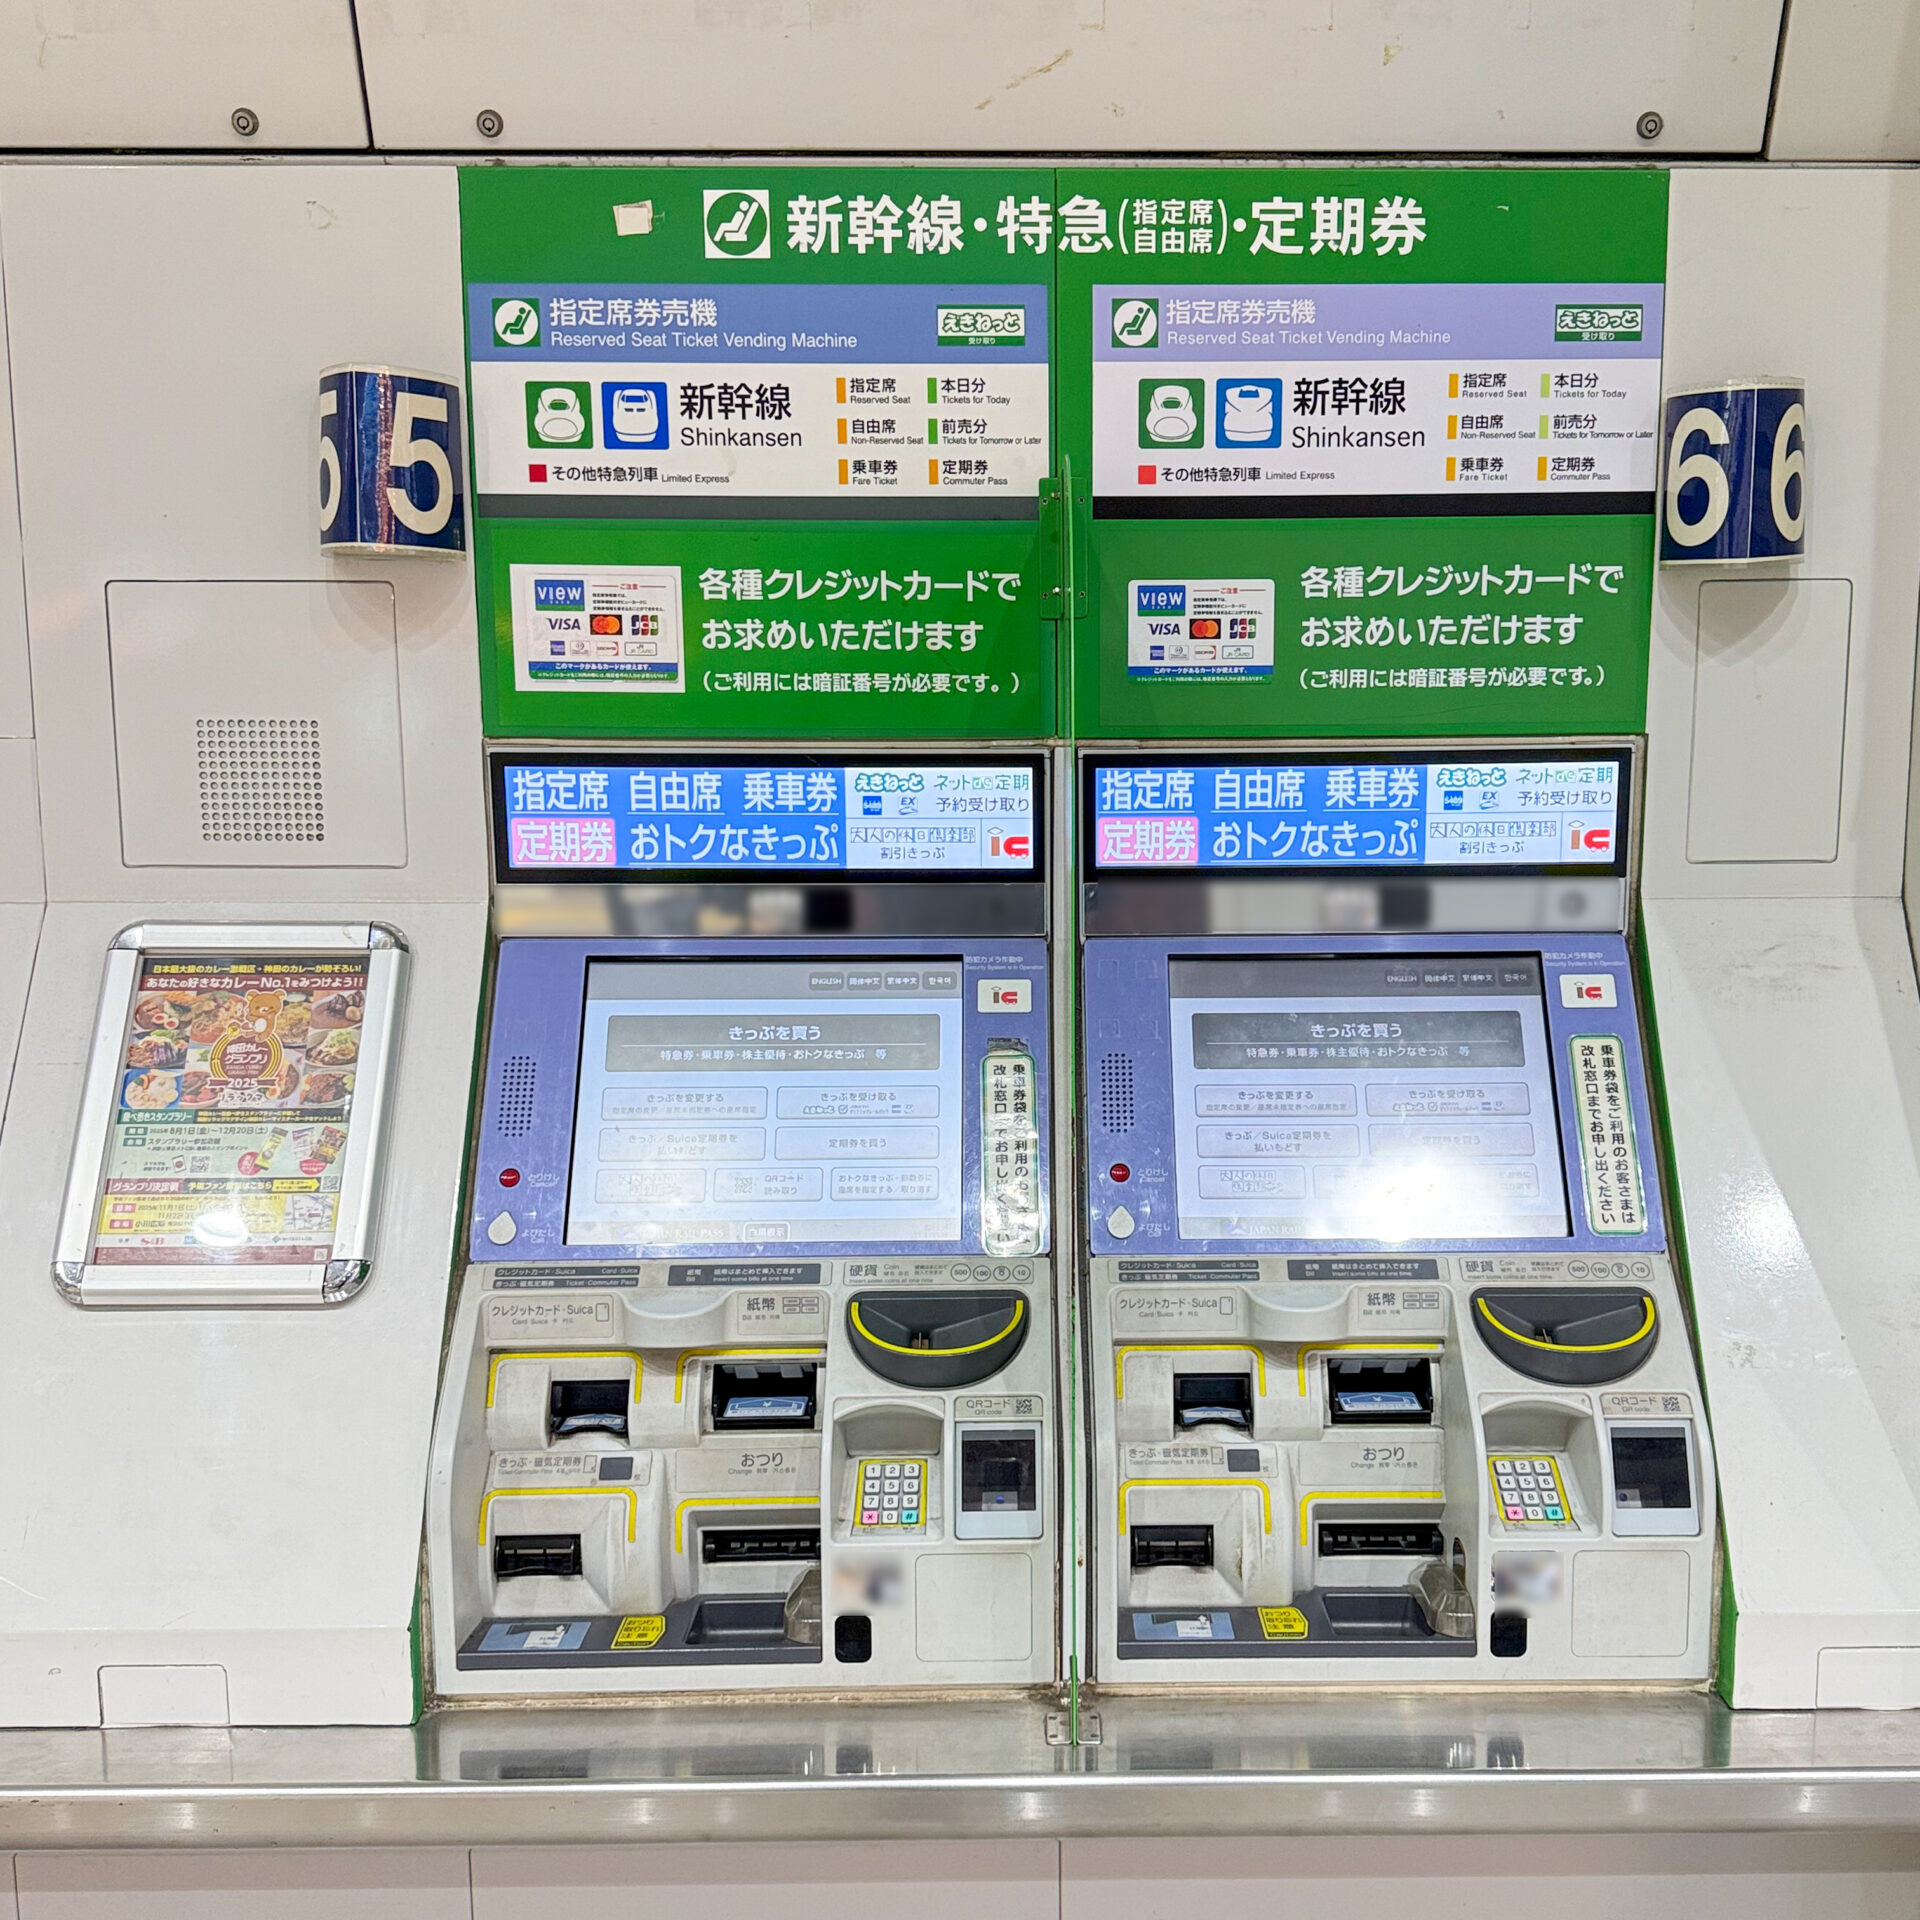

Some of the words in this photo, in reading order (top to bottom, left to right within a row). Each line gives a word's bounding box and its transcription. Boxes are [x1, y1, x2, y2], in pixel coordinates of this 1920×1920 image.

[550, 298, 718, 327] 指定席券売機
[1166, 299, 1316, 325] 指定席券売機
[942, 312, 1020, 333] えきねっと
[1559, 311, 1639, 329] えきねっと
[551, 332, 626, 347] Reserved
[631, 332, 666, 347] Seat
[672, 333, 718, 347] Ticket
[724, 333, 786, 351] Vending
[792, 333, 857, 348] Machine
[1167, 331, 1237, 345] Reserved
[1241, 331, 1274, 345] Seat
[1279, 331, 1322, 344] Ticket
[1327, 330, 1385, 347] Vending
[1390, 331, 1450, 343] Machine
[1582, 332, 1615, 340] 受け取り
[850, 378, 896, 393] 指定席
[941, 378, 986, 392] 本日分
[1463, 373, 1507, 388] 指定席
[1554, 373, 1599, 388] 本日分
[680, 383, 791, 420] 新幹線
[851, 396, 889, 404] Reserved
[892, 396, 910, 404] Seat
[942, 396, 971, 404] Tickets
[973, 396, 983, 404] for
[987, 396, 1010, 405] Today
[1292, 377, 1406, 416] 新幹線
[1462, 390, 1504, 398] Reserved
[1507, 390, 1527, 398] Seat
[1555, 390, 1584, 398] Tickets
[1587, 390, 1598, 398] for
[1602, 390, 1626, 399] Today
[852, 419, 896, 434] 自由席
[942, 419, 987, 434] 前売分
[1461, 415, 1504, 429] 自由席
[1553, 414, 1597, 429] 前売分
[681, 428, 802, 447] Shinkansen
[1292, 427, 1425, 448] Shinkansen
[387, 392, 453, 534] 5
[852, 460, 897, 474] 乗車券
[943, 460, 988, 474] 定期券
[1460, 458, 1504, 471] 乗車券
[1552, 457, 1595, 471] 定期券
[552, 467, 658, 481] その他特急列車
[662, 475, 692, 483] Limited
[695, 475, 729, 483] Express
[1161, 468, 1262, 482] その他特急列車
[1266, 471, 1297, 481] Limited
[1300, 471, 1335, 481] Express
[1667, 407, 1729, 546] 6
[1771, 403, 1805, 542] 6
[699, 568, 1021, 602] 各種クレジットカードで
[1301, 565, 1624, 598] 各種クレジットカードで
[547, 618, 580, 630] VISA
[1147, 624, 1180, 635] VISA
[1301, 614, 1583, 648] お求めいただけます
[702, 619, 983, 651] お求めいただけます
[703, 671, 1020, 693] （ご利用には暗証番号が必要です。）
[1300, 665, 1605, 689] （ご利用には暗証番号が必要です。）
[855, 773, 924, 792] えきねっと
[1437, 768, 1507, 787] えきねっと
[513, 771, 609, 811] 指定席
[630, 771, 722, 811] 自由席
[744, 772, 837, 812] 乗車券
[1102, 770, 1194, 810] 指定席
[1214, 769, 1306, 809] 自由席
[1325, 768, 1419, 809] 乗車券
[1482, 792, 1497, 800] EX
[901, 797, 915, 805] EX
[936, 798, 1029, 812] 予約受け取り
[1518, 791, 1611, 806] 予約受け取り
[851, 827, 975, 843] 大人の休日倶楽部
[1430, 821, 1556, 838] 大人の休日倶楽部
[518, 822, 613, 861] 定期券
[631, 823, 839, 861] おトクなきっぷ
[1104, 820, 1196, 860] 定期券
[1213, 819, 1418, 858] おトクなきっぷ
[881, 847, 945, 859] 割引きっぷ
[1460, 842, 1524, 854] 割引きっぷ
[729, 1025, 821, 1041] きっぷを買う
[1311, 1023, 1402, 1038] きっぷを買う
[225, 1055, 268, 1064] グランプリ
[228, 1078, 258, 1087] 2025
[220, 1093, 262, 1102] リラックマ
[648, 1094, 724, 1102] きっぷを変更する
[821, 1093, 896, 1101] きっぷを受け取る
[1238, 1091, 1313, 1100] きっぷを変更する
[1409, 1090, 1485, 1098] きっぷを受け取る
[1581, 1046, 1615, 1224] 改札窓口までお申し出ください
[1601, 1046, 1636, 1223] 乗車券袋をご利用のお客さまは
[829, 1139, 886, 1148] 定期券を買う
[850, 1265, 878, 1276] 硬貨
[1465, 1260, 1494, 1272] 硬貨
[746, 1298, 775, 1311] 紙幣
[1120, 1299, 1217, 1309] クレジットカード・Suica
[1367, 1293, 1396, 1306] 紙幣
[492, 1305, 593, 1316] クレジットカード・Suica
[966, 1400, 1010, 1409] QRコード
[1612, 1397, 1657, 1405] QRコード
[741, 1452, 783, 1467] おつり
[1363, 1447, 1405, 1462] おつり
